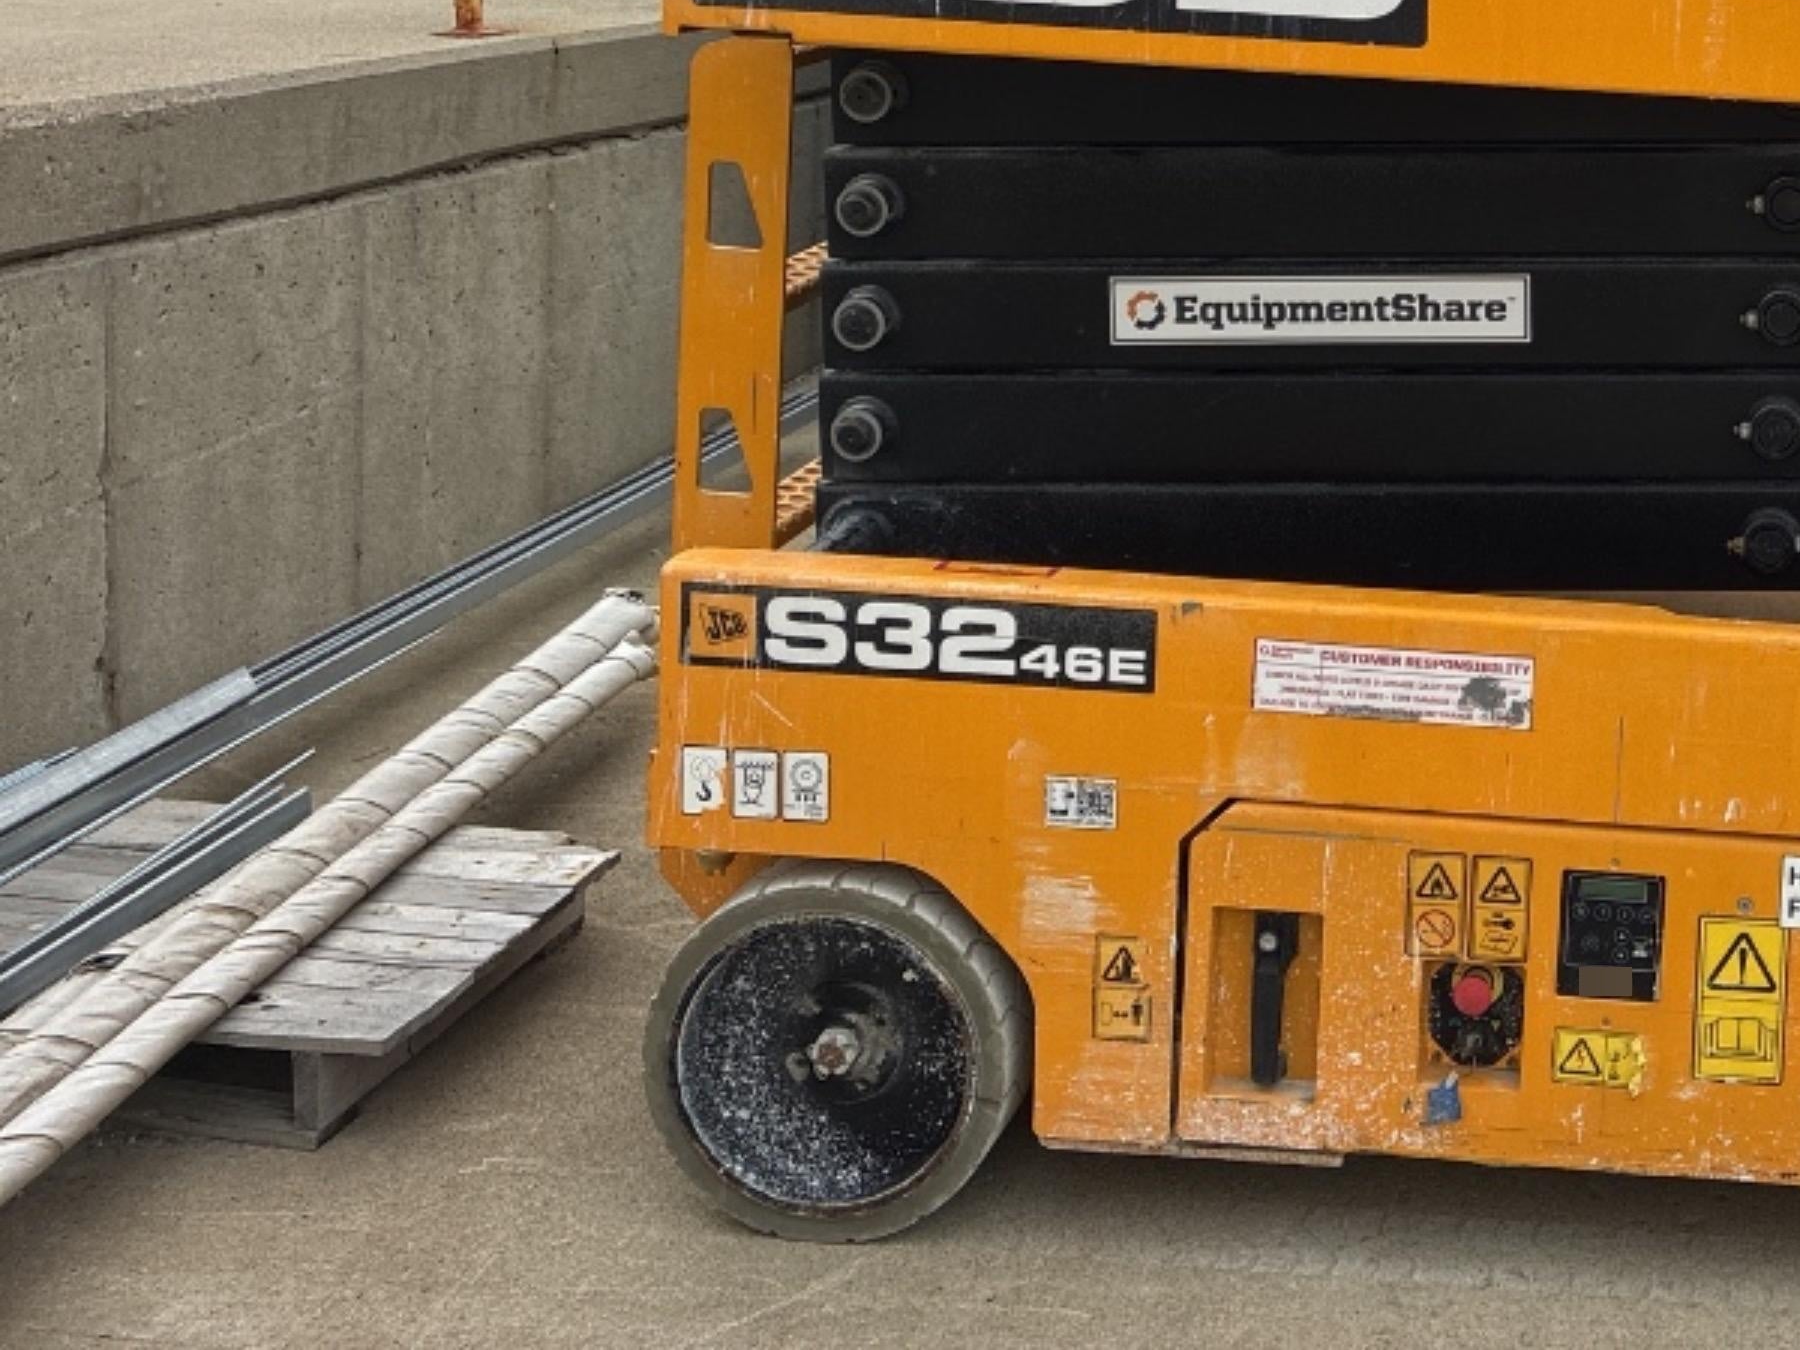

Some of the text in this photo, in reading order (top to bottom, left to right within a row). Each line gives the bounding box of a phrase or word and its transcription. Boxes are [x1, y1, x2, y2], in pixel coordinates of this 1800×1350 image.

[1173, 293, 1508, 330] EquipmentShare
[706, 607, 748, 640] JCB
[764, 595, 1018, 677] S32
[1320, 650, 1402, 666] CUSTOMER
[1406, 655, 1531, 676] RESPONSIBILITY
